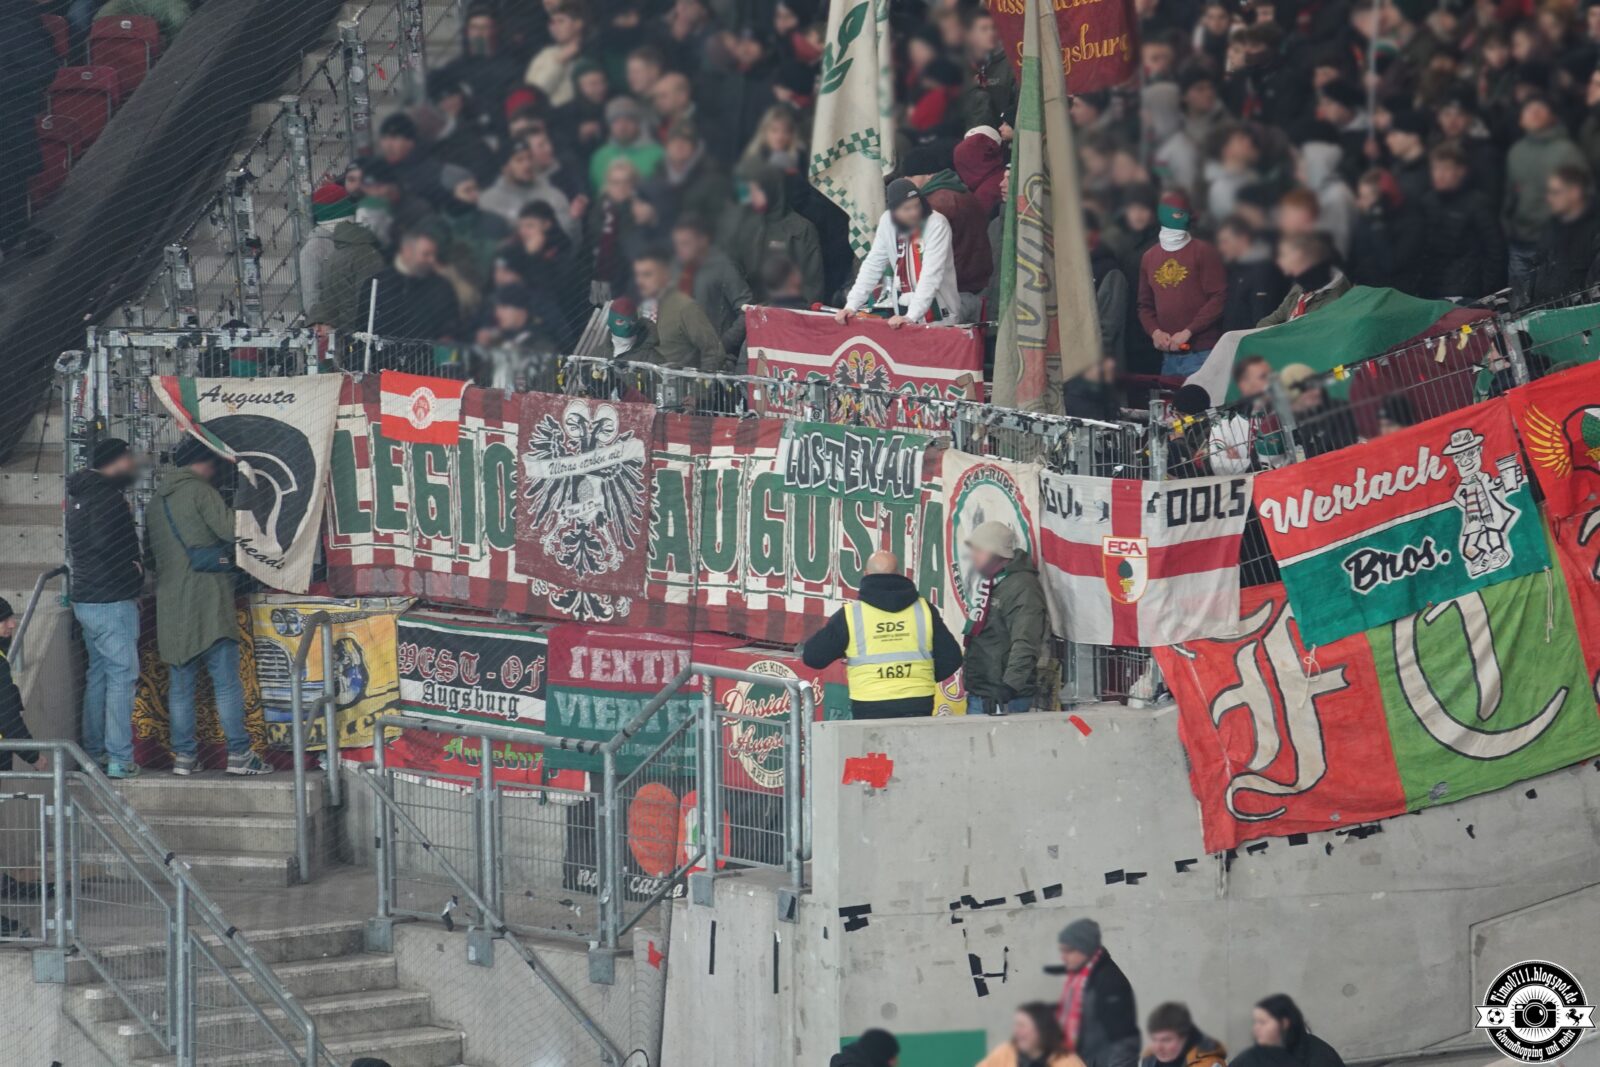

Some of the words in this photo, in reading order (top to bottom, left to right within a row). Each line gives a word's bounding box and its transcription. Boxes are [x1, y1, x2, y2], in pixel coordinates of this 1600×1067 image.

[199, 384, 297, 410] Augusta
[784, 431, 919, 499] LUSTENAU
[1258, 446, 1448, 534] Wertach
[331, 421, 517, 551] LEGIO
[649, 466, 946, 609] AUGUSTA
[1108, 540, 1143, 556] FCA
[1343, 537, 1452, 593] Bros.
[876, 621, 905, 633] SDS
[752, 662, 769, 674] THE
[770, 661, 790, 677] KIDS
[877, 663, 912, 679] 1687
[421, 680, 521, 720] Augsburg
